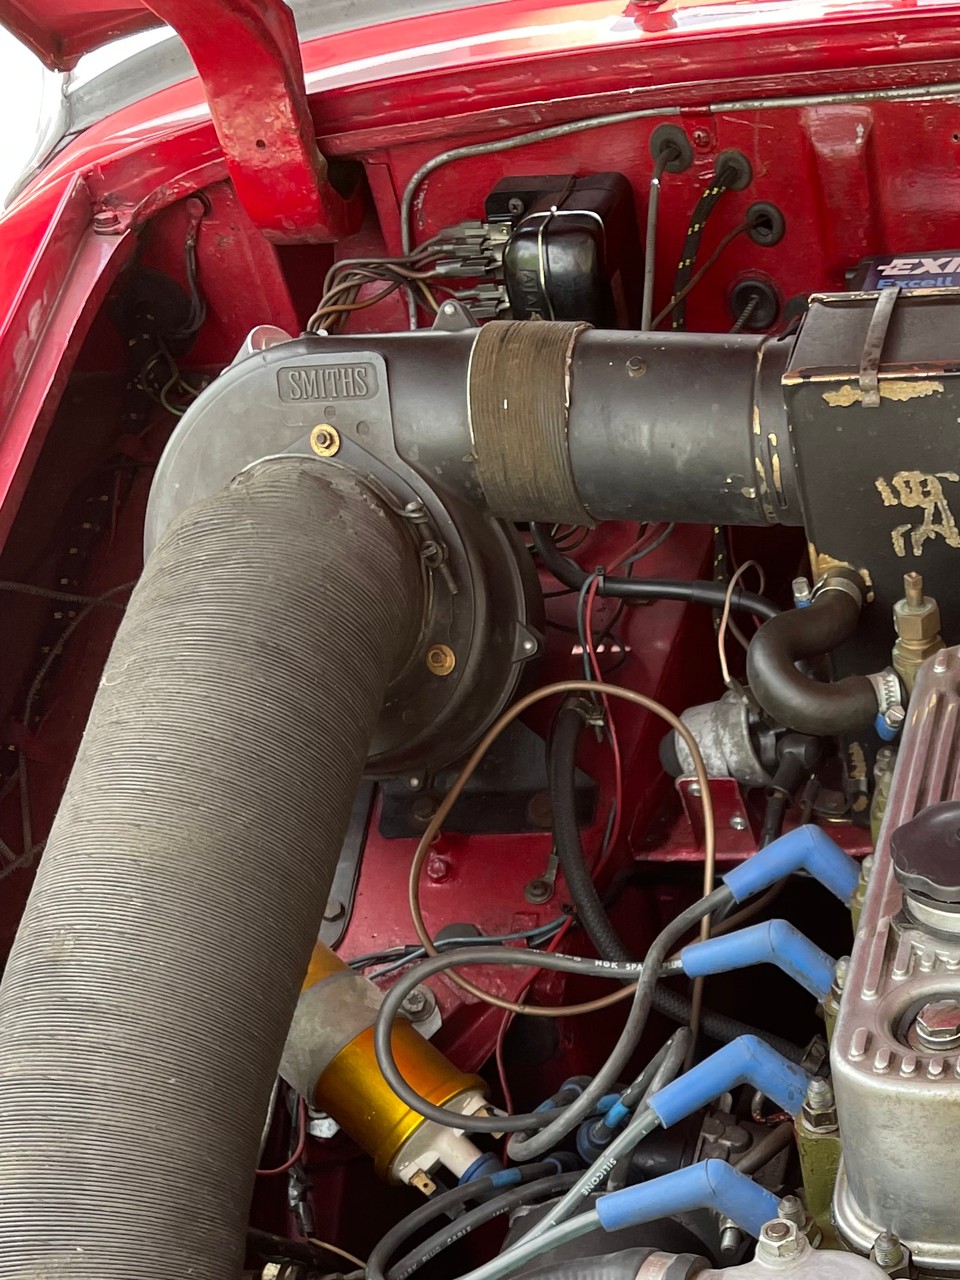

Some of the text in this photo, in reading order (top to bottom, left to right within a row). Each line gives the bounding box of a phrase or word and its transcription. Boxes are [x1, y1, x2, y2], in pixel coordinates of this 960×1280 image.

[876, 277, 954, 290] Excell
[288, 367, 369, 400] SMITHS
[580, 1157, 618, 1197] SILICONE
